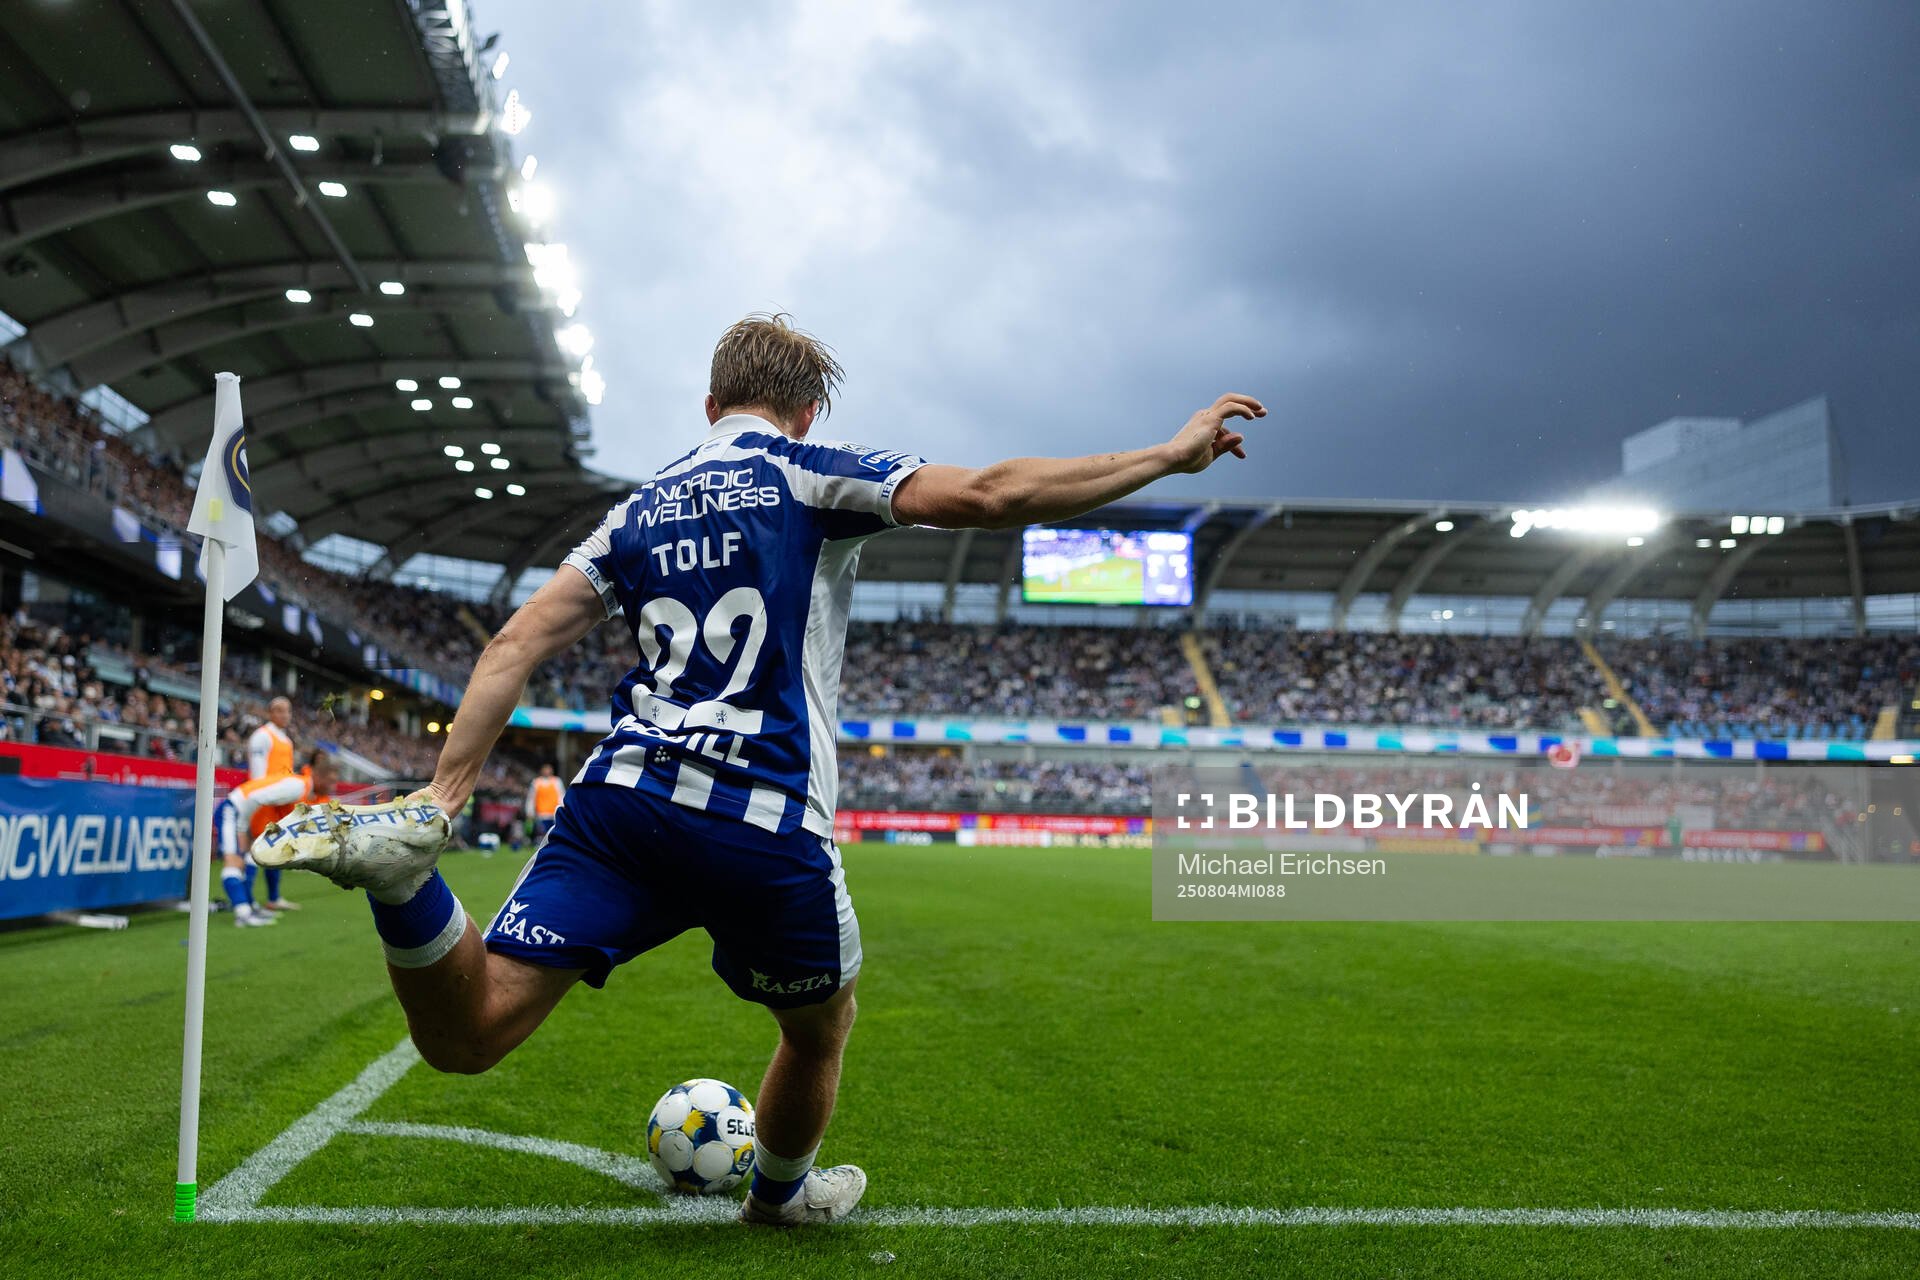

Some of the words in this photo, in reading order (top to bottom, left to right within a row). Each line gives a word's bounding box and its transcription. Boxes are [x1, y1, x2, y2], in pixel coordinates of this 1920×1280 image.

[654, 467, 754, 505] NORDIC
[881, 478, 898, 499] IFK
[637, 486, 780, 530] WELLNESS
[651, 531, 742, 577] TOLF
[585, 565, 602, 587] IFK
[632, 586, 768, 735] 22
[752, 973, 832, 994] RASTA
